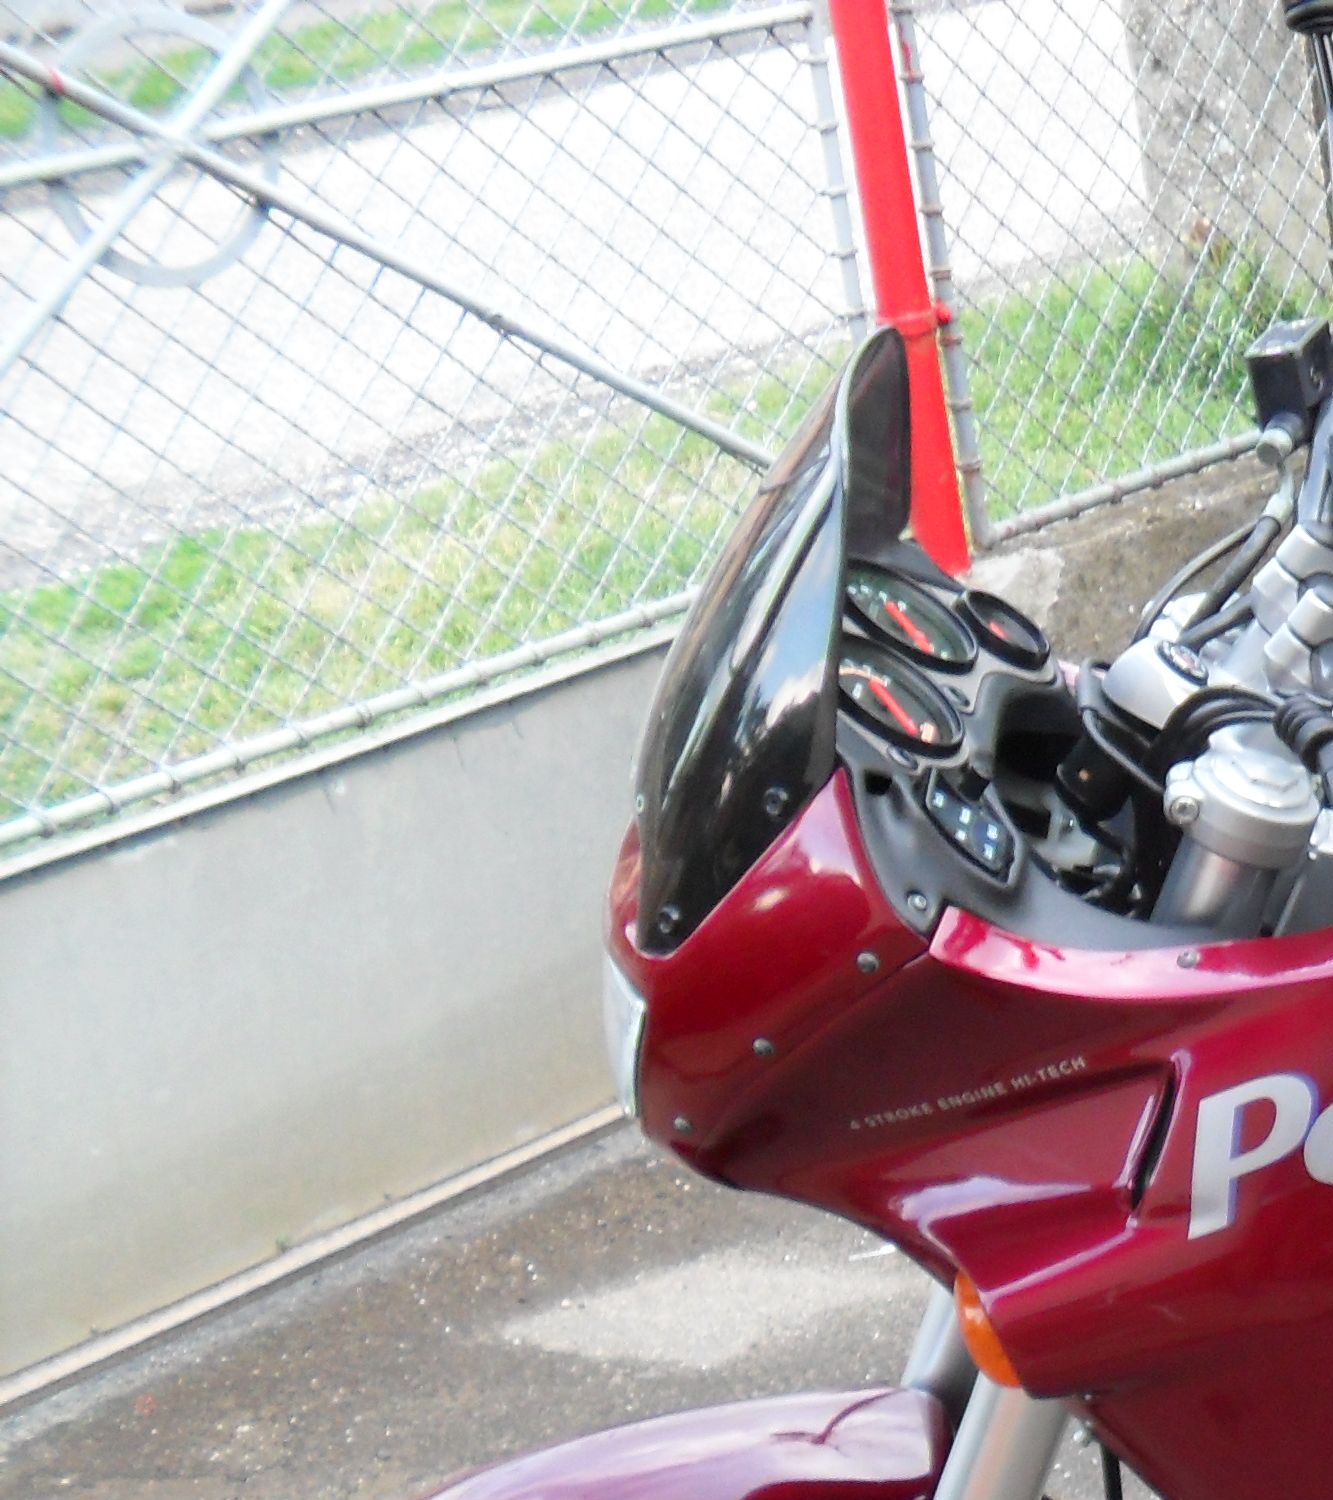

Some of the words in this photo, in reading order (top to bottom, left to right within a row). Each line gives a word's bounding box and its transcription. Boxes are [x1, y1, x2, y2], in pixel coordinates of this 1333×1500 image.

[864, 1102, 933, 1127] STROKE
[937, 1081, 1007, 1110] ENGINE
[1010, 1055, 1086, 1090] HI-TECH
